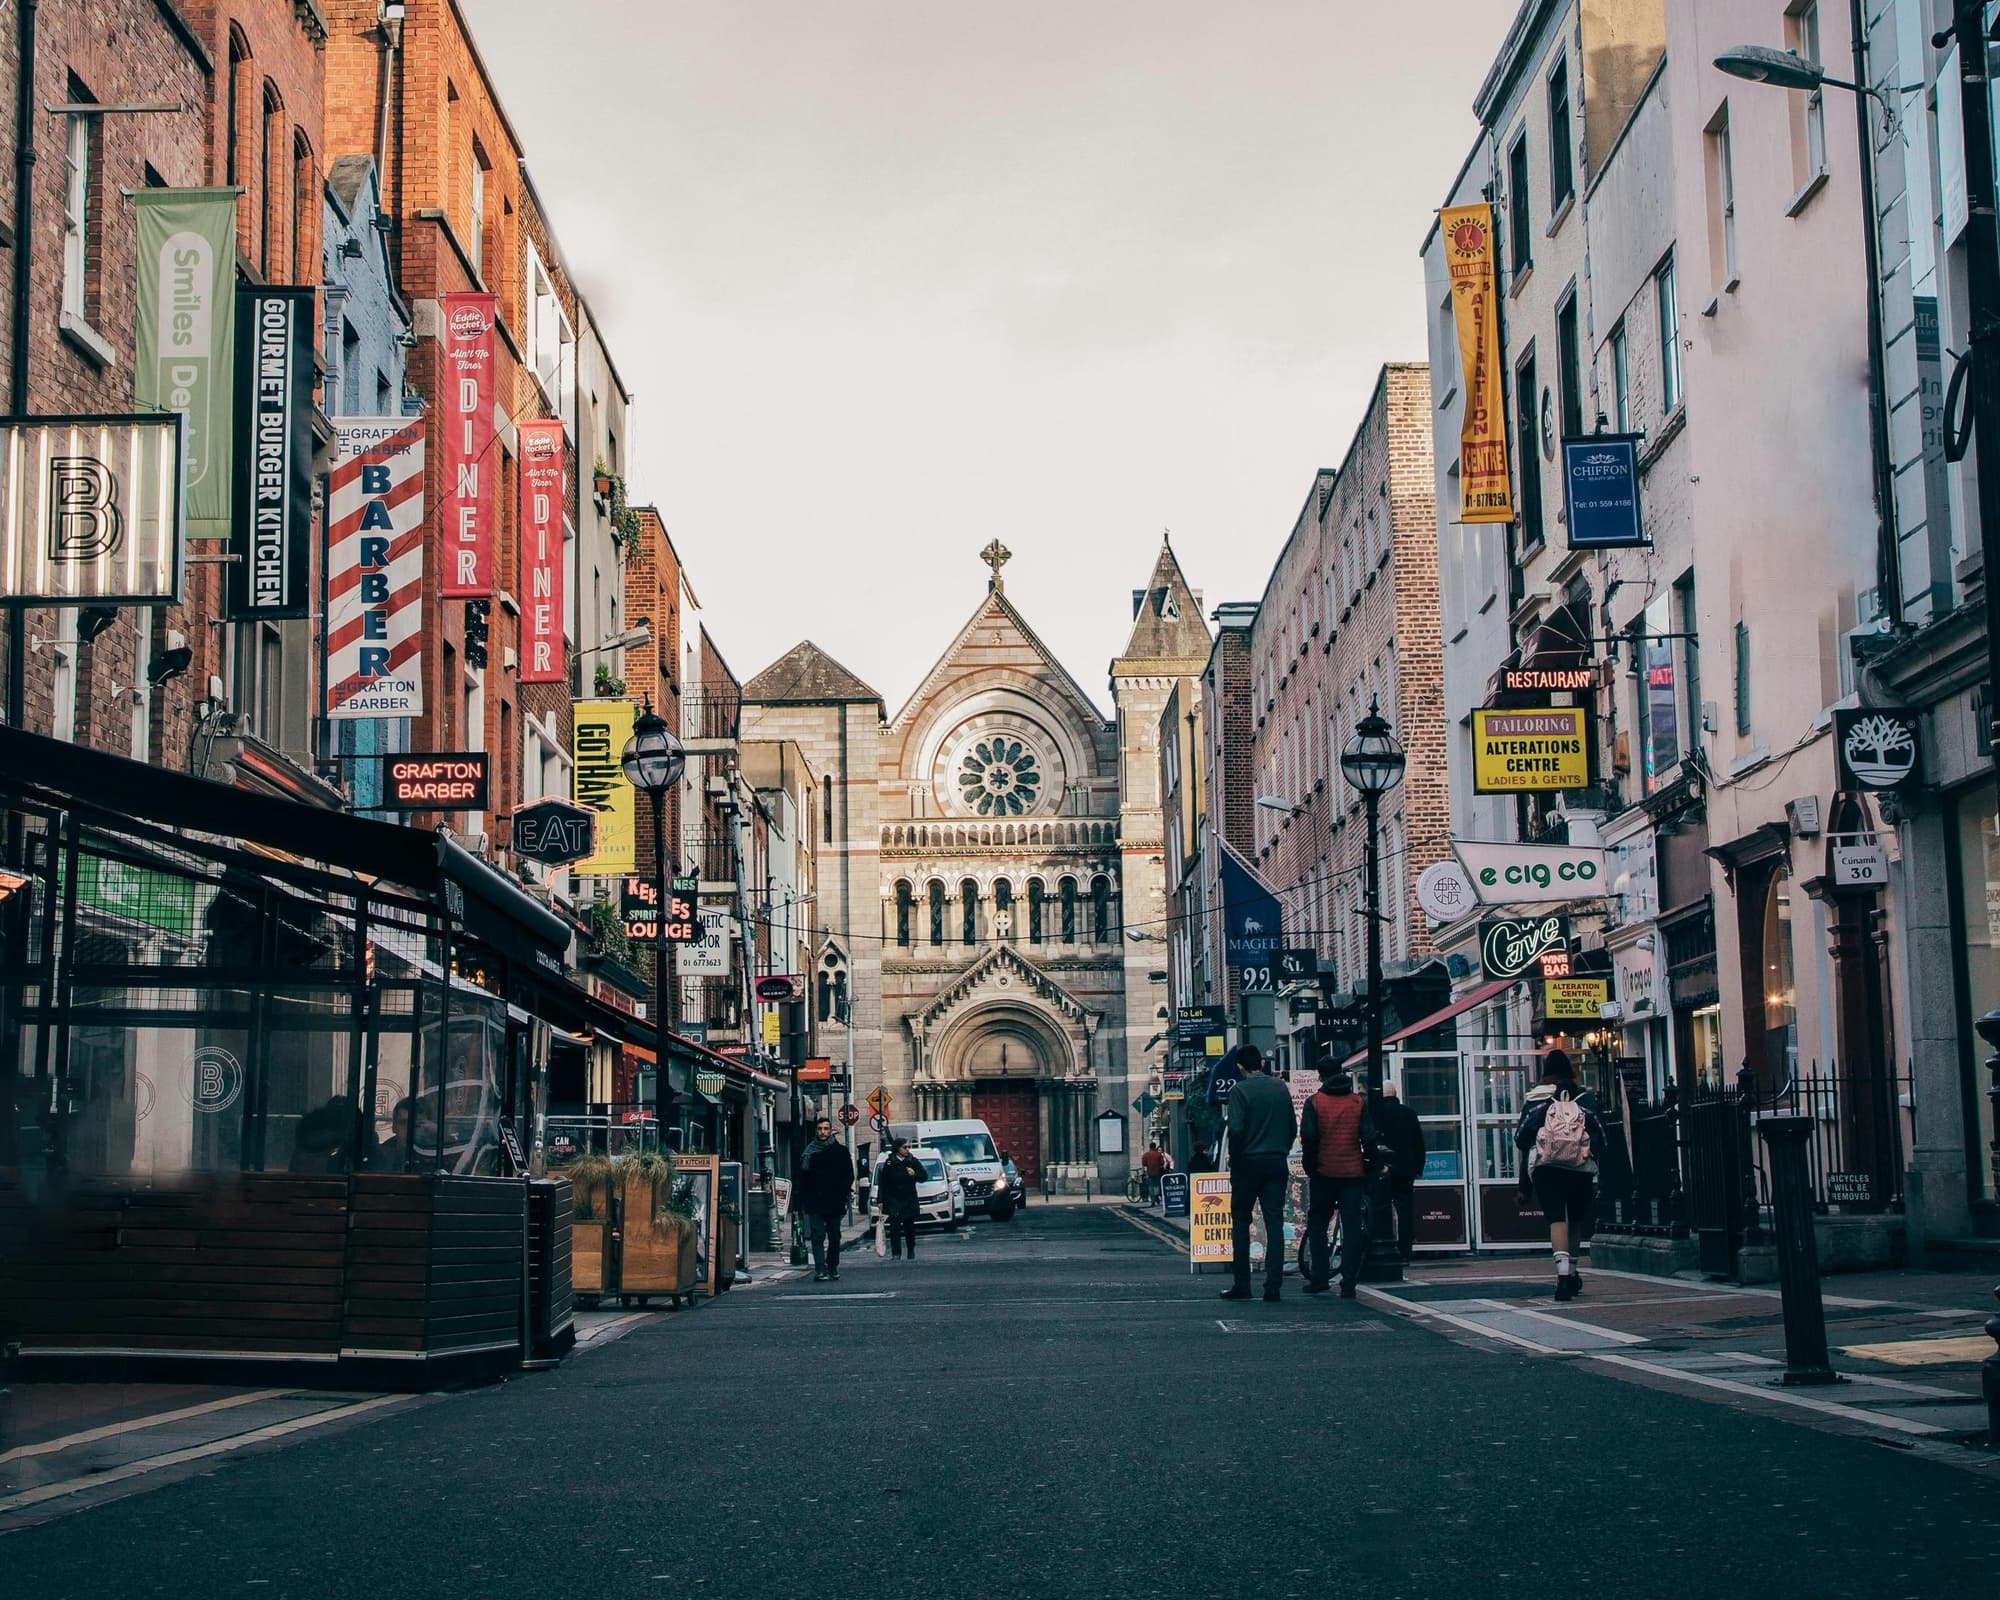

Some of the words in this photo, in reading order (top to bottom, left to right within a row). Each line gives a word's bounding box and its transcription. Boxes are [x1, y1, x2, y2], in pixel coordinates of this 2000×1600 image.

[173, 248, 200, 346] Smiles
[455, 314, 480, 322] Eddie
[260, 299, 286, 406] GOURMET
[450, 348, 474, 358] Ain't
[475, 349, 489, 359] No
[457, 360, 482, 370] Finer
[1470, 293, 1489, 436] ALTERATION
[351, 428, 418, 439] GRAFTON
[339, 428, 350, 455] THE
[258, 412, 284, 500] BURGER
[352, 444, 411, 455] BARBER
[1464, 445, 1504, 473] CENTRE
[1573, 465, 1628, 476] CHIFFON
[457, 377, 479, 585] DINER
[48, 456, 119, 561] B
[256, 508, 282, 606] KITCHEN
[358, 464, 393, 677] BARBER
[533, 494, 552, 673] DINER
[1506, 671, 1591, 688] RESTAURANT
[350, 681, 415, 692] GRAFTON
[349, 698, 409, 710] BARBER
[1492, 718, 1570, 732] TAILORING
[1486, 740, 1580, 755] ALTERATIONS
[393, 763, 482, 779] GRAFTON
[1506, 758, 1560, 772] CENTRE
[1487, 777, 1526, 785] LADIES
[1531, 776, 1538, 784] &
[1542, 775, 1581, 784] GENTS
[398, 783, 475, 799] BARBER
[519, 816, 588, 852] EAT
[1841, 855, 1877, 864] Cúnamh
[1480, 868, 1497, 886] e
[1505, 864, 1551, 889] cig
[1558, 860, 1597, 881] co
[1851, 867, 1872, 879] 30
[1522, 920, 1535, 930] LA
[1229, 938, 1279, 950] MAGEE
[1484, 918, 1560, 977] Cave
[683, 959, 691, 967] 01
[1540, 954, 1569, 964] WINE
[1543, 964, 1569, 976] BAR
[1243, 967, 1273, 991] 22
[1190, 1009, 1203, 1017] Let
[200, 1061, 224, 1098] B
[839, 1111, 859, 1120] SOP
[555, 1136, 569, 1146] CAN
[1830, 1174, 1870, 1182] BICYCLES
[1197, 1179, 1232, 1193] TAILOR
[1834, 1183, 1855, 1191] WILL
[1857, 1183, 1867, 1191] BE
[1831, 1192, 1870, 1201] REMOVED
[1194, 1213, 1233, 1225] ALTERAT
